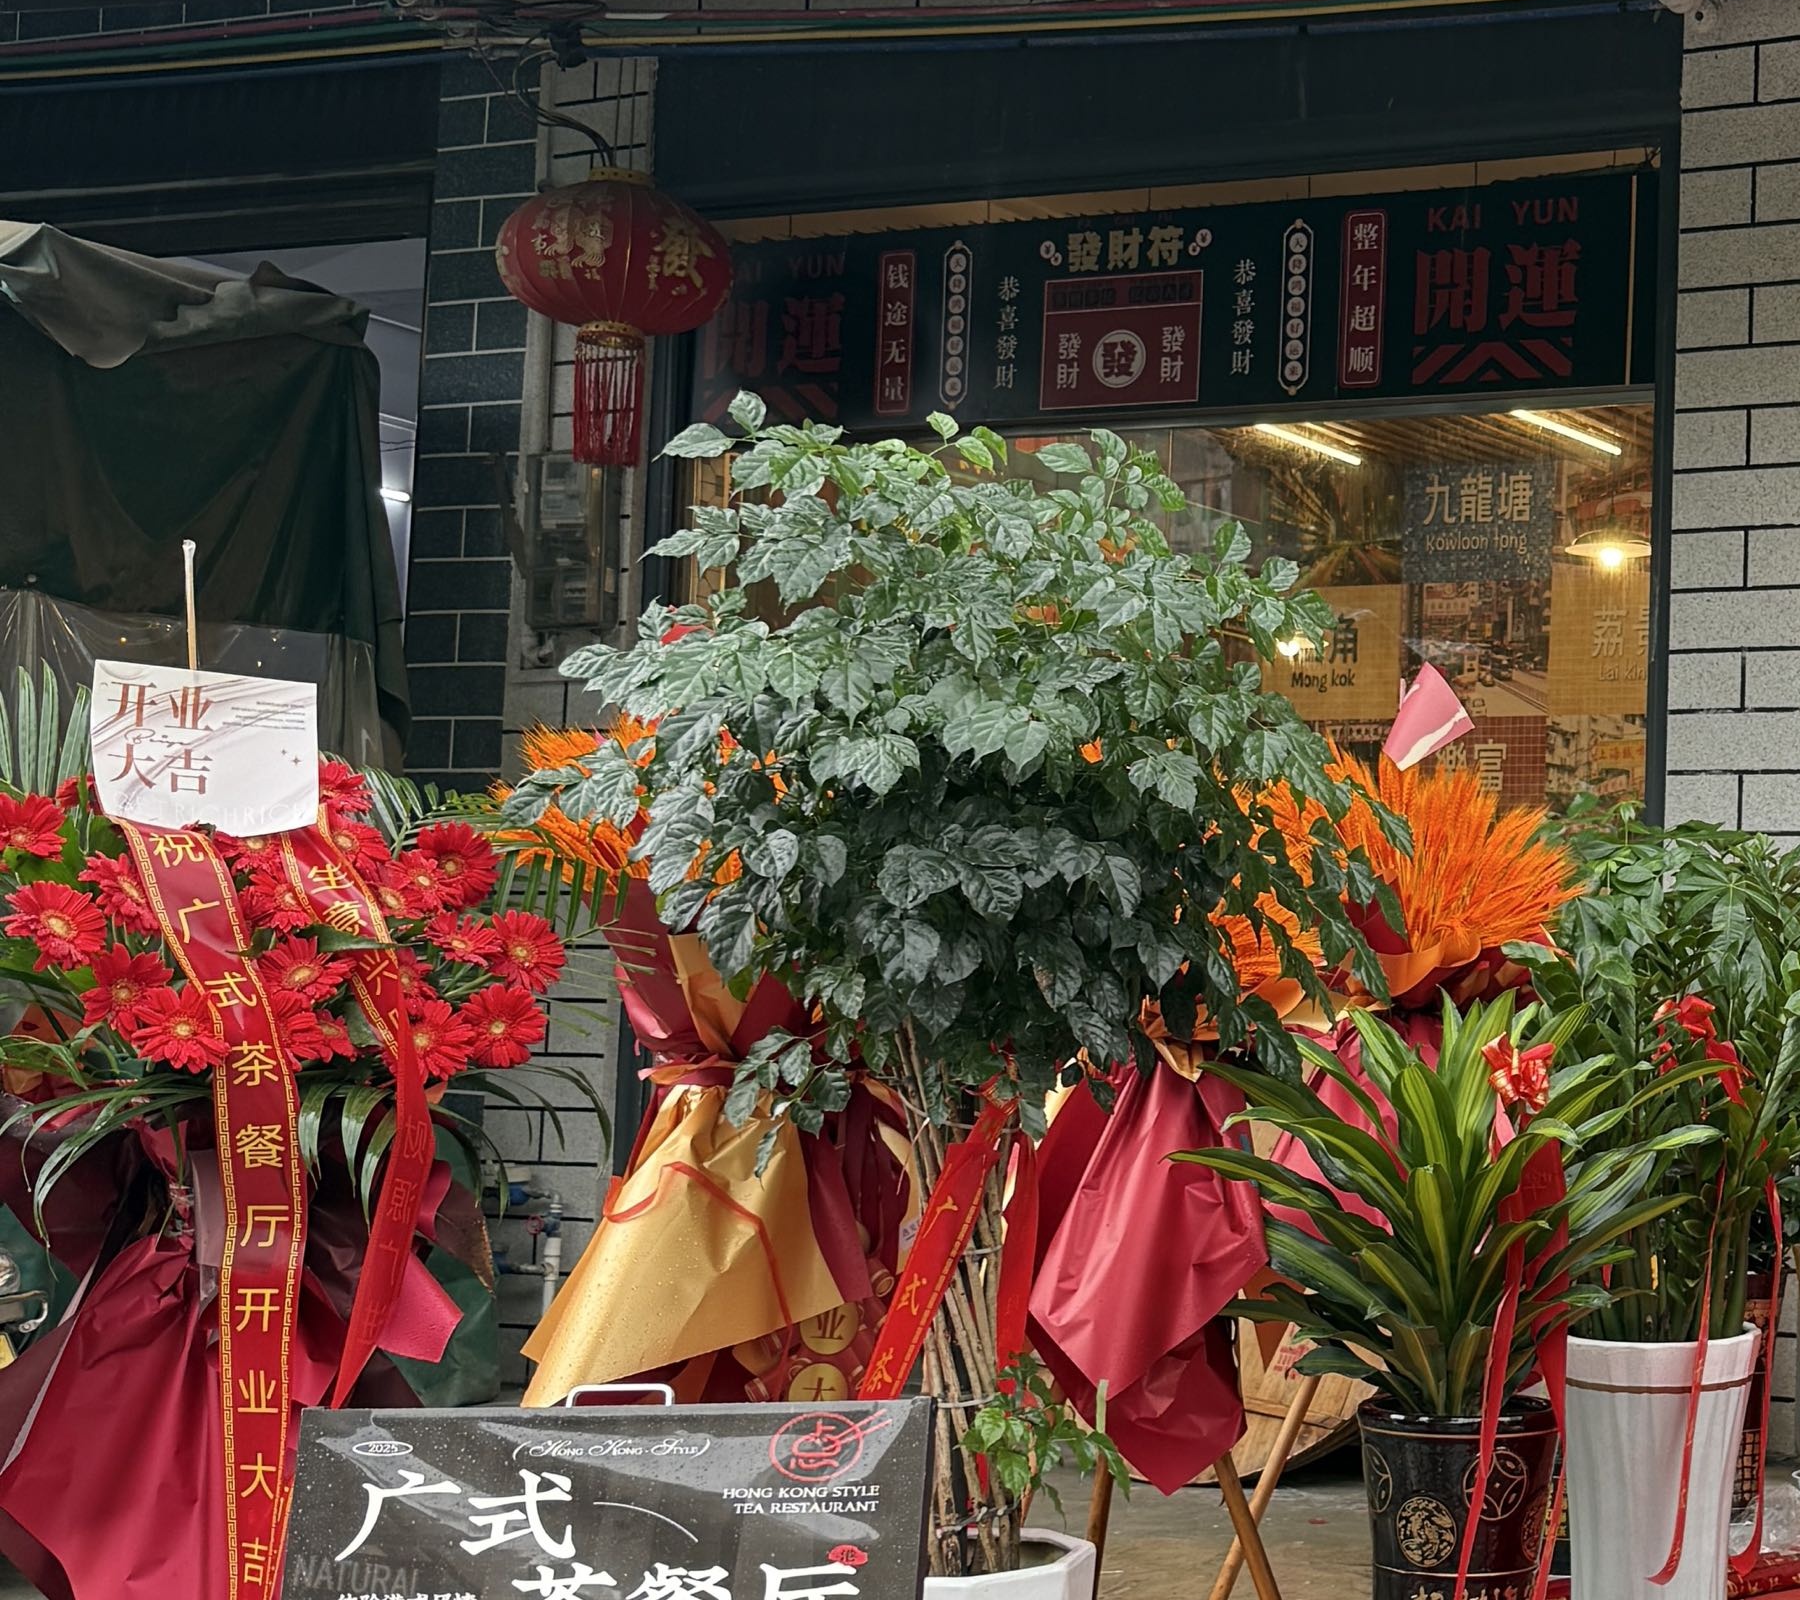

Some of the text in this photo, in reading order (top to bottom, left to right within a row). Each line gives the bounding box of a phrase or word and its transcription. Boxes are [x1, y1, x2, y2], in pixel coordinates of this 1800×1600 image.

[1427, 196, 1579, 233] KAI YUN
[1347, 222, 1379, 374] 整年超顺
[1412, 238, 1582, 335] 開運
[883, 262, 910, 402] 钱途无量
[1422, 469, 1534, 525] 九龍塘
[107, 681, 215, 732] 开业
[1290, 670, 1329, 693] Mong
[107, 743, 214, 796] 大吉
[150, 833, 285, 1586] 祝广式茶餐厅开业大吉
[367, 1442, 399, 1454] 2025
[334, 1468, 577, 1562] 广式
[722, 1484, 880, 1500] HONG KONG STYLE
[734, 1500, 880, 1515] TEA RESTAURANT
